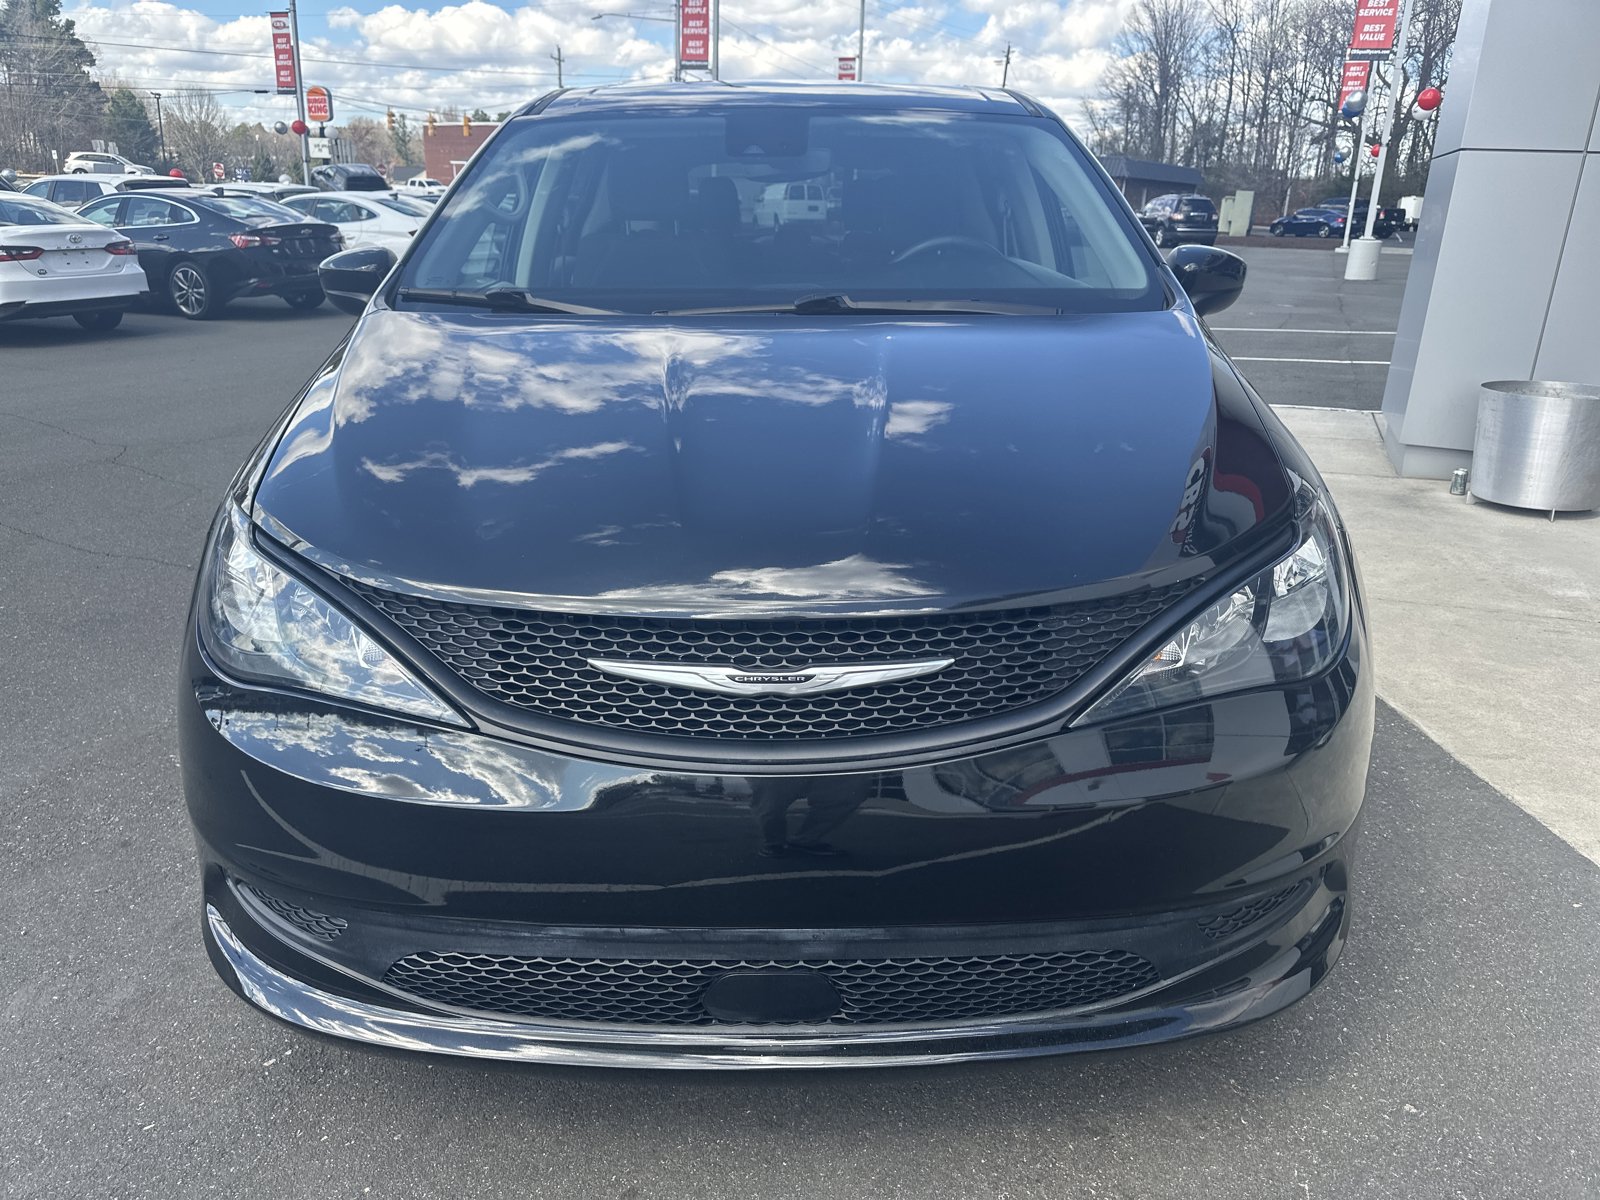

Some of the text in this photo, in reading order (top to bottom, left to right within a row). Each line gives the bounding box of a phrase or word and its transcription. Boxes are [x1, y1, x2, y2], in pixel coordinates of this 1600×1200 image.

[1358, 8, 1395, 17] SERVICE
[683, 27, 707, 35] SERVICE
[1363, 24, 1386, 32] BEST
[1359, 33, 1386, 41] VALUE
[308, 105, 328, 114] KING
